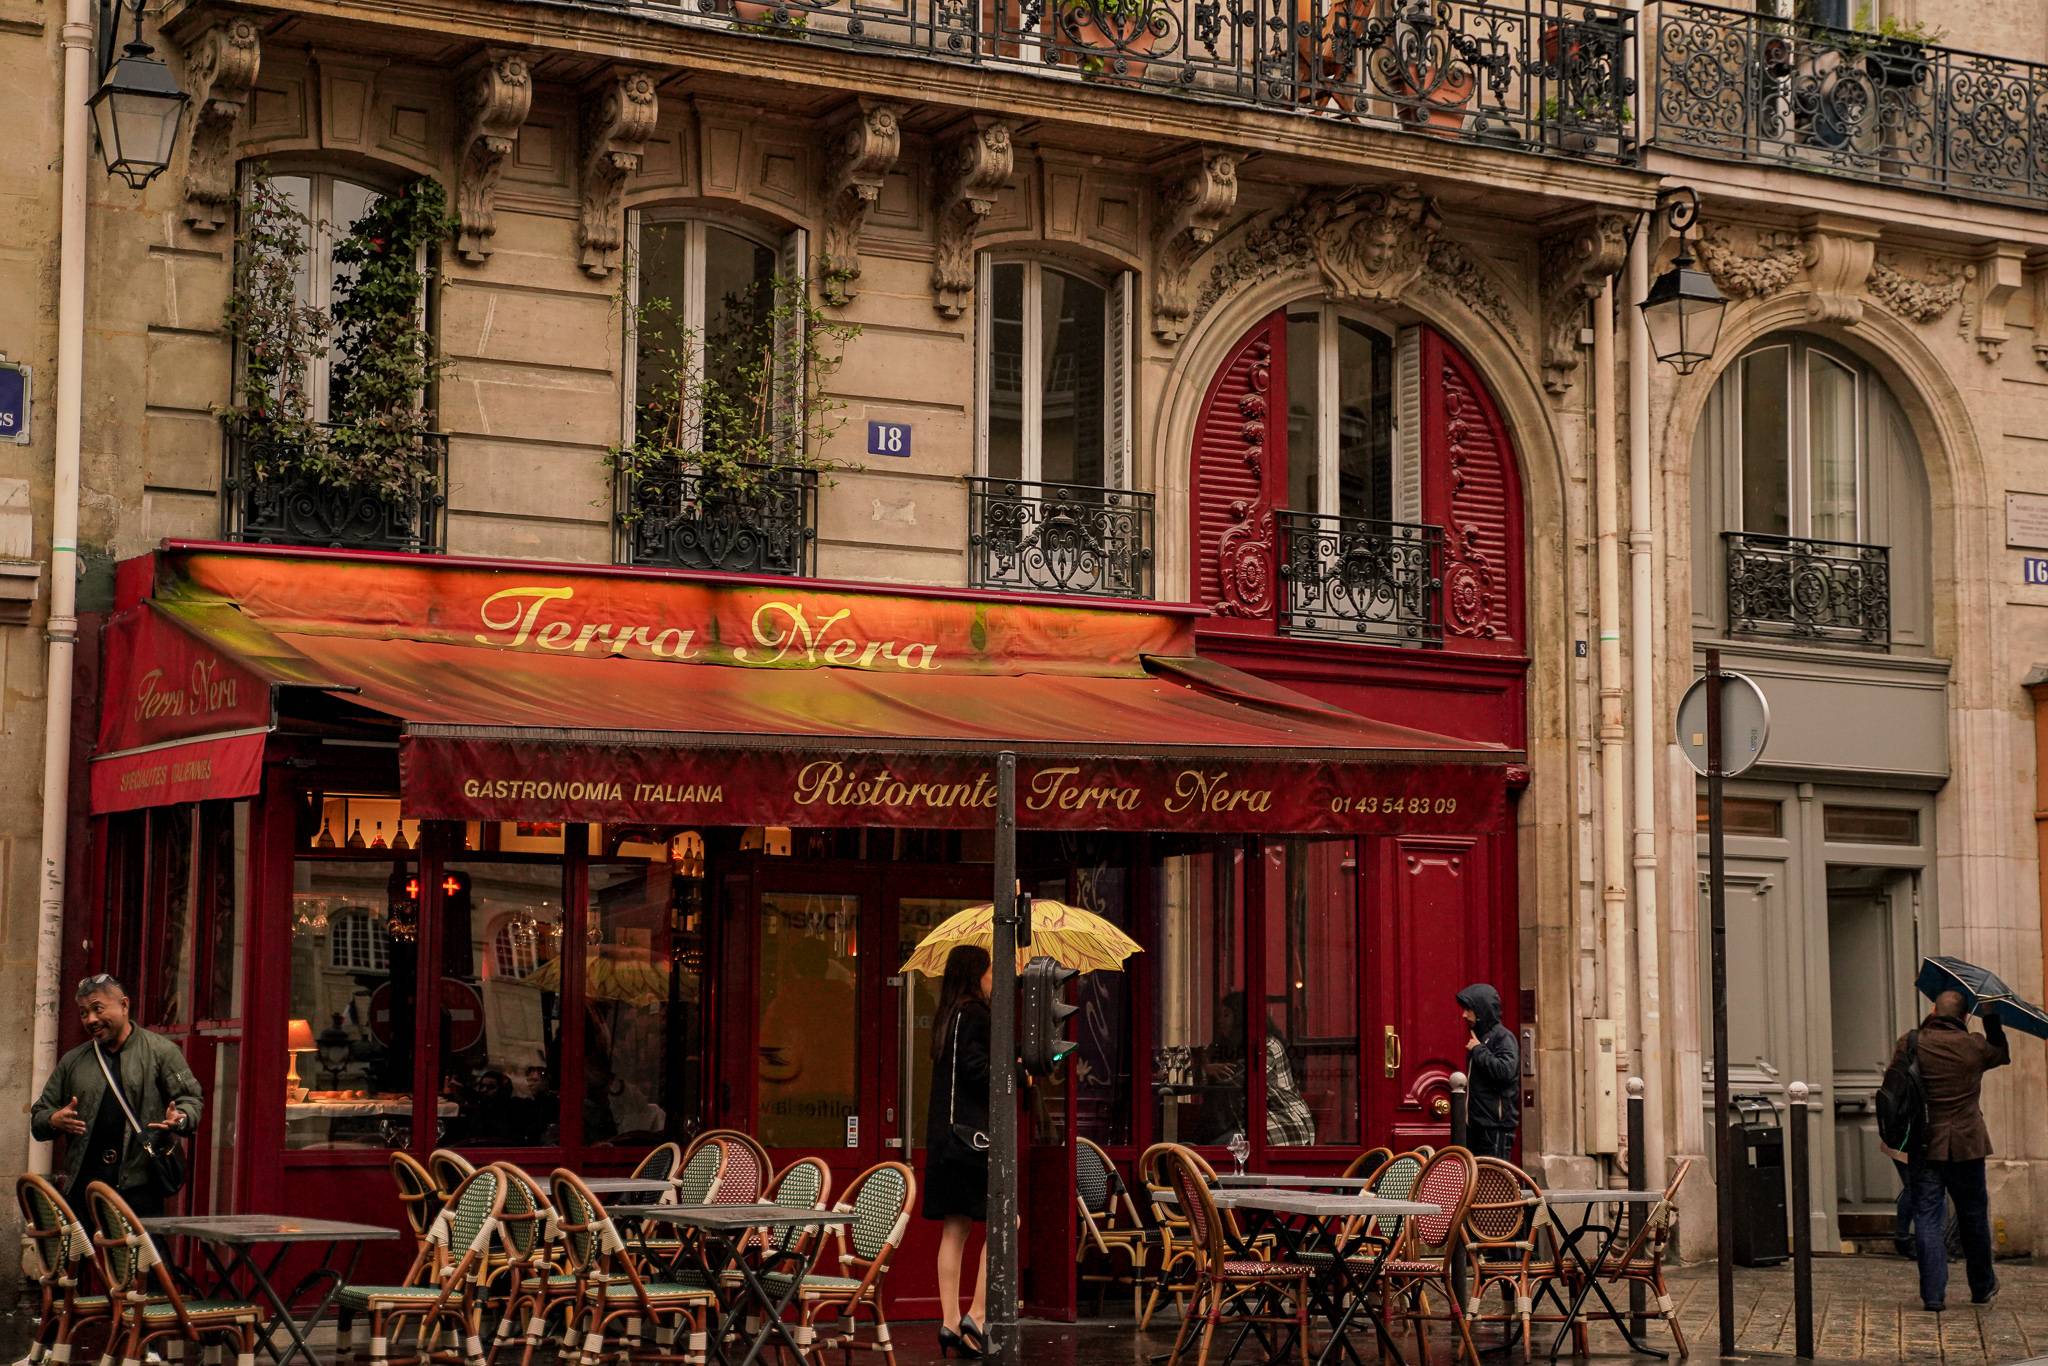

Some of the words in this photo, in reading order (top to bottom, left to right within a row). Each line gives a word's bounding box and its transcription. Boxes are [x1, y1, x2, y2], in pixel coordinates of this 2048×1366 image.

[878, 425, 902, 452] 18
[2028, 560, 2048, 583] 16
[475, 586, 698, 659] Terra
[733, 601, 942, 670] Nera
[135, 669, 185, 722] Terra
[190, 658, 239, 715] Nera
[464, 779, 622, 801] GASTRONOMIA
[633, 784, 723, 803] ITALIANA
[793, 760, 998, 808] Ristorante
[1026, 766, 1142, 811] Terra
[1164, 769, 1272, 813] Nera
[1331, 797, 1350, 813] 01
[1355, 798, 1377, 814] 43
[1382, 798, 1404, 814] 54
[1407, 798, 1430, 814] 83
[1434, 798, 1457, 814] 09
